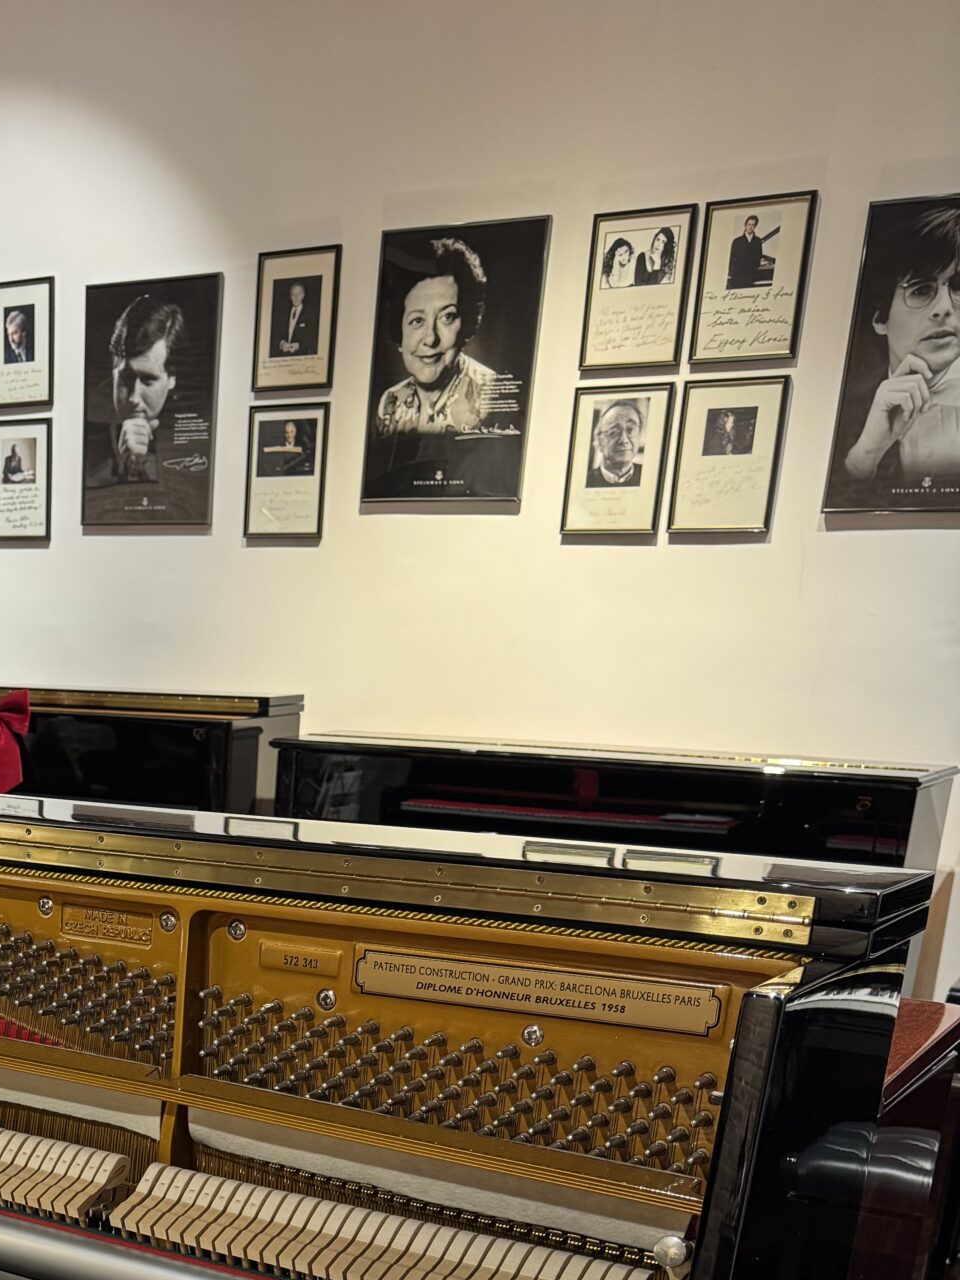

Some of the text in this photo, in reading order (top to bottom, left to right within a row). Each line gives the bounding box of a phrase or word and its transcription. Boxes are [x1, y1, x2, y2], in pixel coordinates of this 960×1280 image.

[84, 909, 128, 926] MADE IN
[64, 920, 152, 942] CZECH REPUBLIC
[283, 954, 319, 970] 572 343
[373, 960, 416, 975] PATENTED
[418, 966, 490, 983] CONSTRUCTION
[498, 975, 531, 988] GRAND
[534, 979, 557, 991] PRIX:
[559, 983, 617, 998] BARCELONA
[620, 989, 672, 1004] BRUXELLES
[674, 996, 701, 1007] PARIS
[416, 981, 626, 1014] DIPLOME D'HONNEUR BRUXELLES 1958
